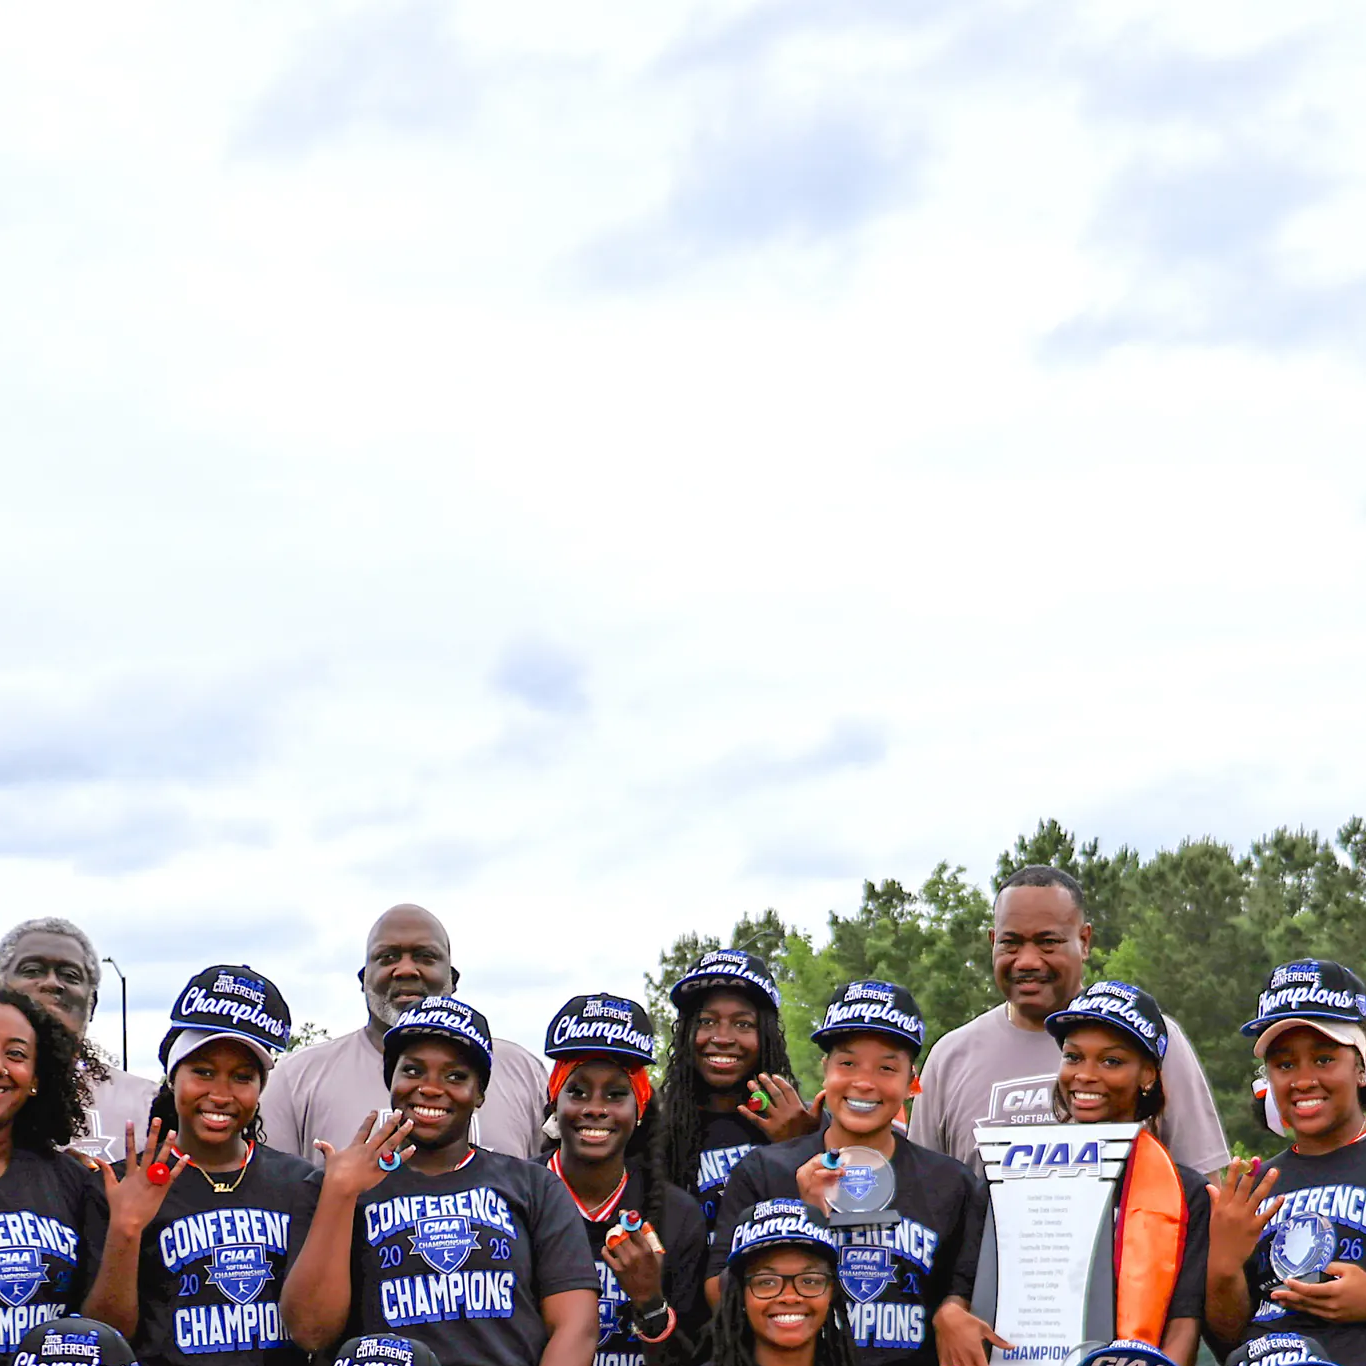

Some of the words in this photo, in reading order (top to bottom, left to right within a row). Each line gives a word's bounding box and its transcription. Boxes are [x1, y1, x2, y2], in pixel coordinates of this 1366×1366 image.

[700, 954, 749, 967] CONFERENCE
[1271, 970, 1321, 989] CONFERENCE
[212, 982, 266, 1005] CONFERENCE
[844, 990, 894, 1002] CONFERENCE
[1087, 984, 1136, 1001] CONFERENCE
[181, 986, 284, 1038] Champions
[421, 999, 473, 1017] CONFERENCE
[583, 1007, 634, 1022] CONFERENCE
[825, 1002, 919, 1033] Champions
[553, 1015, 653, 1051] Champions
[1001, 1141, 1101, 1178] CIAA
[365, 1187, 517, 1245] CONFERENCE
[753, 1205, 807, 1220] CONFERENCE
[424, 1221, 460, 1234] CIAA
[731, 1214, 836, 1252] Champions
[418, 1239, 472, 1249] CHAMPIONSHIP
[1339, 1238, 1363, 1261] 26
[220, 1250, 257, 1264] CIAA
[379, 1244, 403, 1269] 20
[489, 1237, 511, 1260] 26
[846, 1250, 882, 1263] CIAA
[214, 1271, 267, 1280] CHAMPIONSHIP
[838, 1270, 889, 1280] CHAMPIONSHIP
[850, 1264, 877, 1272] SOFTBALL
[178, 1274, 199, 1297] 20
[381, 1270, 517, 1326] CHAMPIONS
[64, 1334, 98, 1345] CIAA
[380, 1338, 413, 1351] CIAA
[1248, 1338, 1305, 1358] CONFERENCE
[41, 1343, 101, 1357] CONFERENCE
[356, 1346, 414, 1363] CONFERENCE
